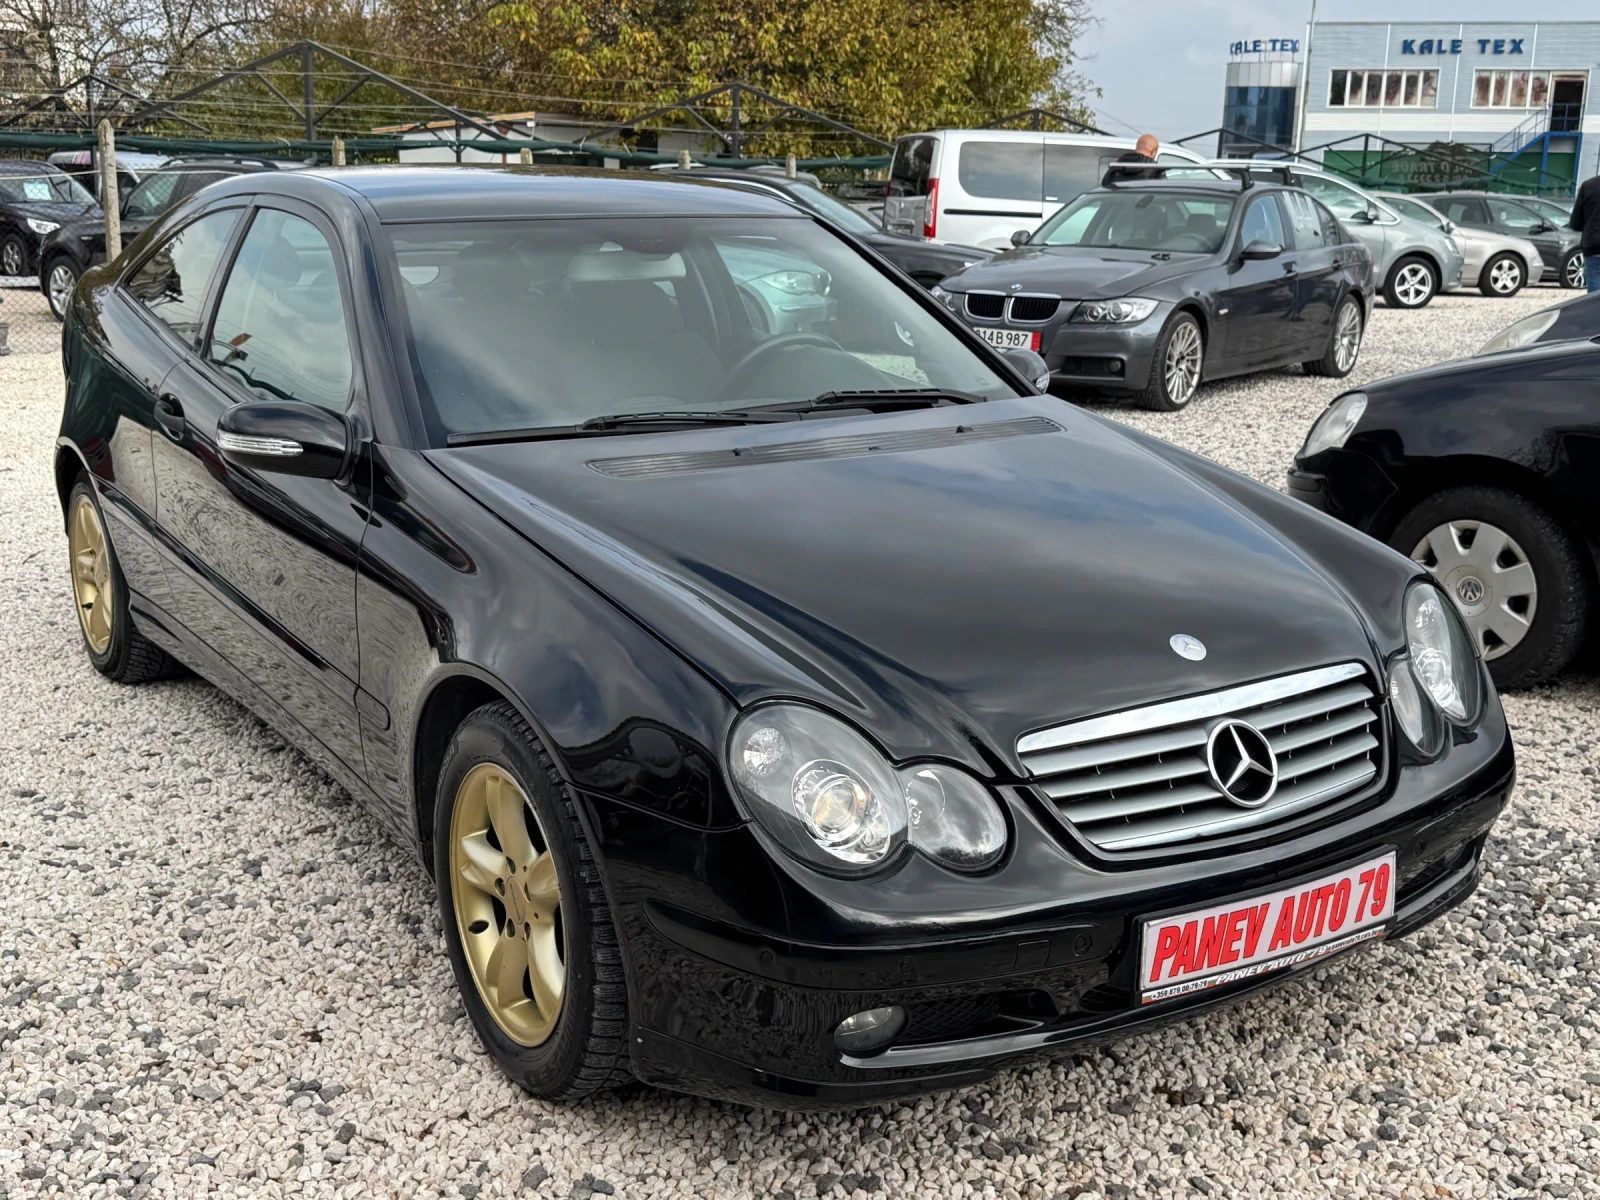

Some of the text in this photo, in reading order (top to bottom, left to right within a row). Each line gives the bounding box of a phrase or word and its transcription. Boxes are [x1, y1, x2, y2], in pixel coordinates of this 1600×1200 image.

[1229, 38, 1299, 55] KALE TEX
[1401, 39, 1525, 55] KALE TEX
[1149, 862, 1391, 983] PANEV AUTO 79
[1215, 946, 1327, 985] PANEV AUTO 79
